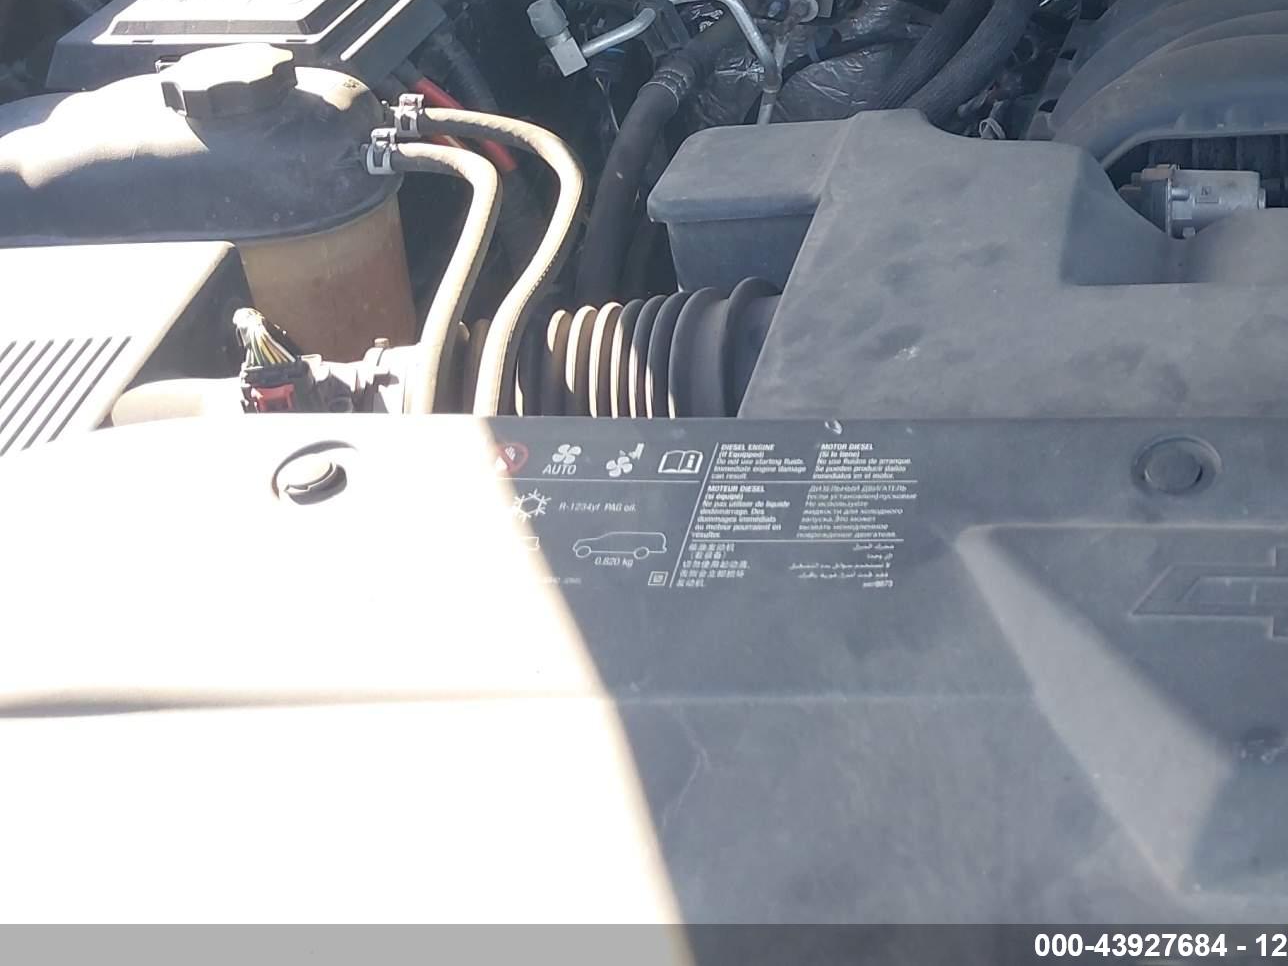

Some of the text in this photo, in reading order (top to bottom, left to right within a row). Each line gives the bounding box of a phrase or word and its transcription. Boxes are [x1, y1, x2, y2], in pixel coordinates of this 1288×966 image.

[848, 443, 874, 451] DIESEL
[543, 464, 577, 475] AUTO
[622, 557, 635, 569] kg
